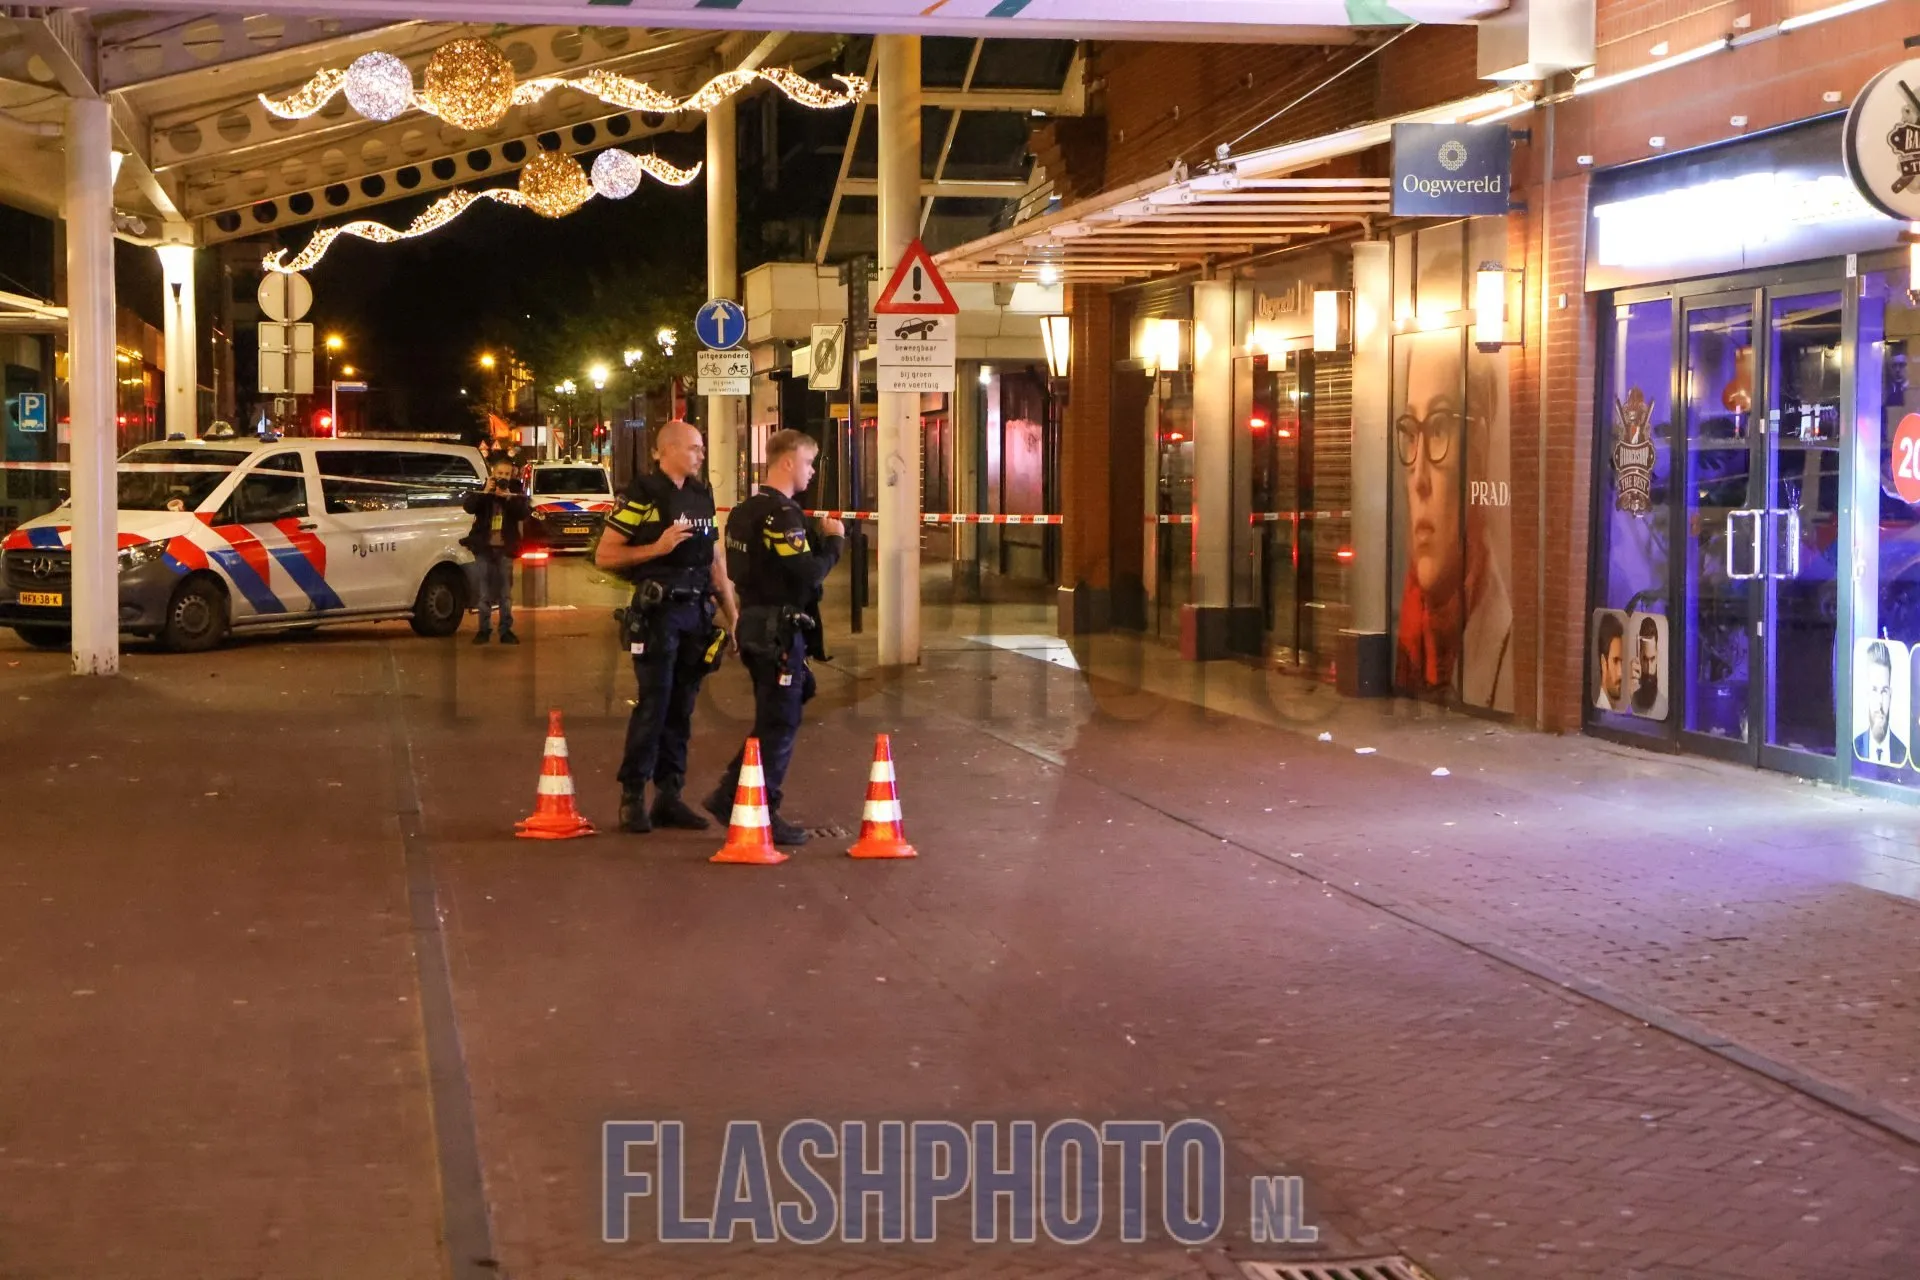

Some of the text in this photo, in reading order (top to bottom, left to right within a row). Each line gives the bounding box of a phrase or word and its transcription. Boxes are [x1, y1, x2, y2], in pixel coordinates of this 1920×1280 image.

[1905, 128, 1920, 150] BA
[1910, 161, 1920, 172] T
[1403, 174, 1501, 198] Oogwereld
[894, 344, 937, 352] beweegbaar
[699, 352, 749, 361] uitgezonderd
[900, 371, 910, 379] bij
[909, 381, 939, 390] voertuig
[25, 396, 39, 416] P
[1621, 475, 1647, 491] THE BEST
[1471, 481, 1511, 506] PRAD
[22, 593, 58, 604] HFX-38-K
